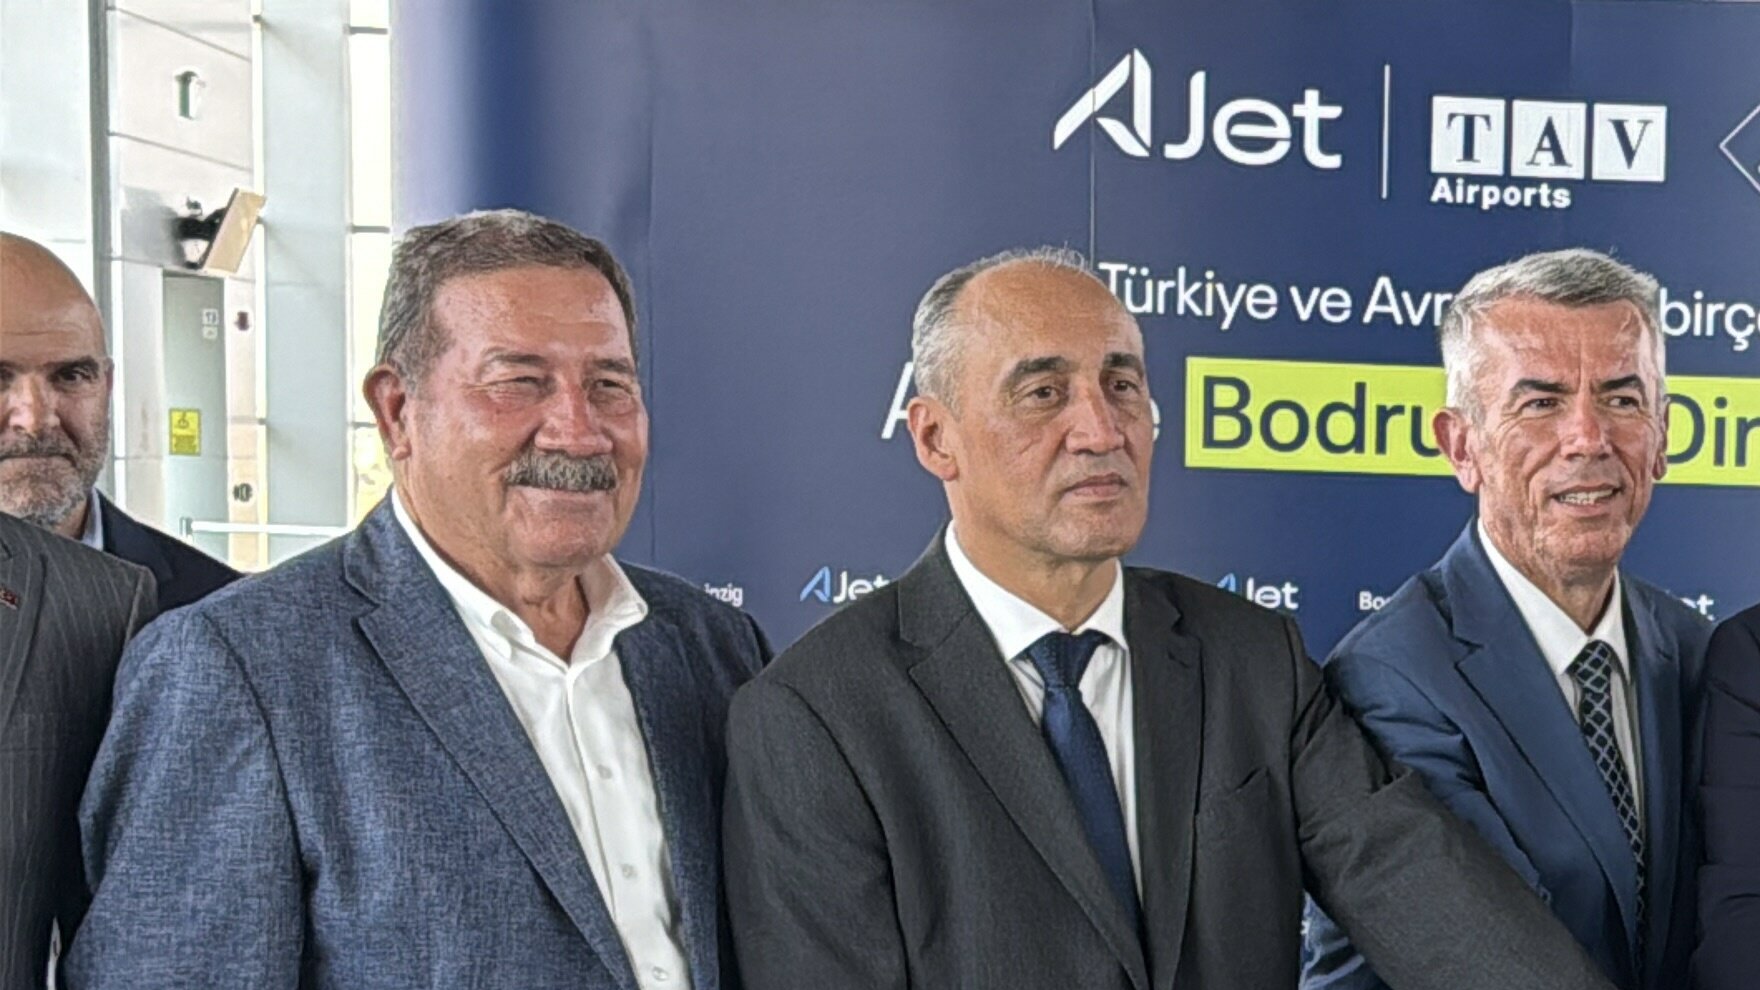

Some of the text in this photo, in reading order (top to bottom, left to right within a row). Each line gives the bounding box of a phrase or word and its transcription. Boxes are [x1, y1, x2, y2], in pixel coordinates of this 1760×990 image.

[1054, 48, 1342, 169] AJet
[1442, 108, 1658, 173] TAV
[1430, 177, 1572, 210] Airports
[1099, 262, 1278, 330] Türkiye
[1290, 287, 1352, 322] ve
[1202, 375, 1442, 458] Bodru
